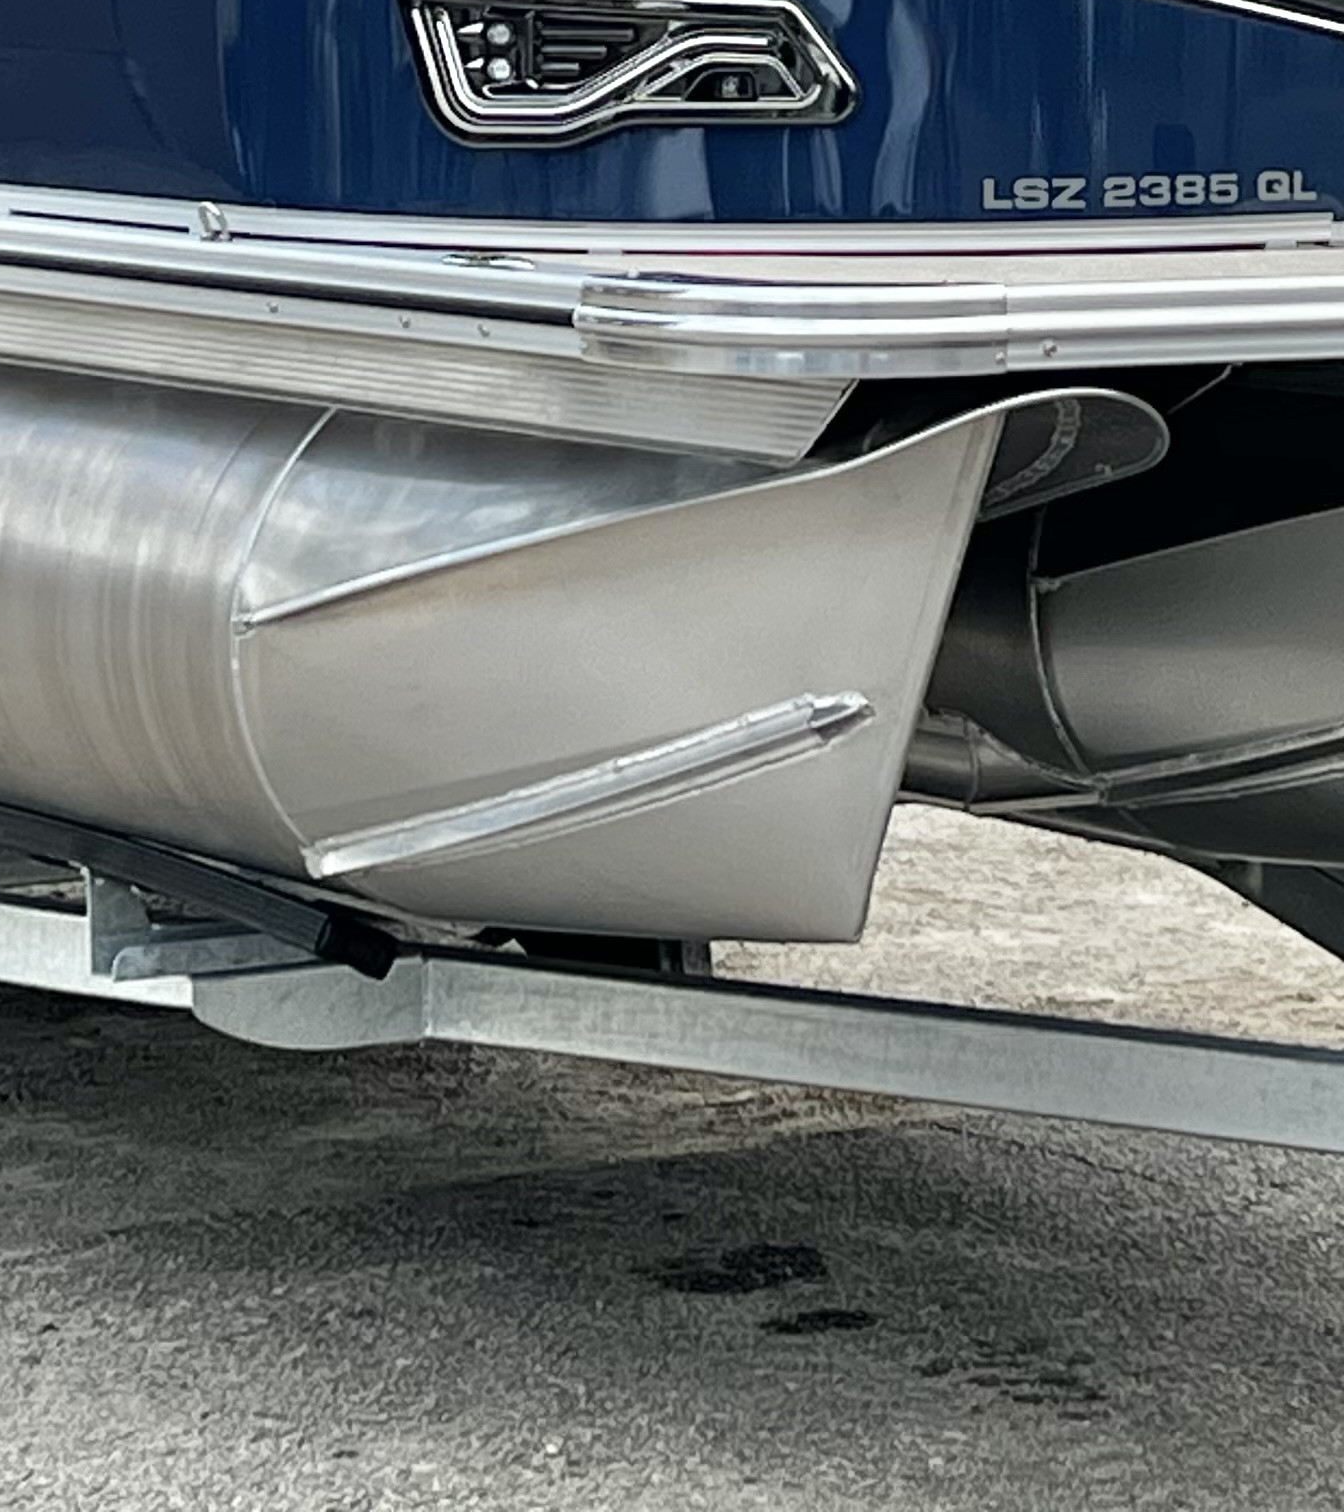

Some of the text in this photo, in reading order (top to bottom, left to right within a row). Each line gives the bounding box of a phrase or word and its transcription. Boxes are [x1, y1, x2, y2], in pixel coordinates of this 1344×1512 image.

[982, 170, 1317, 209] LSZ 2385 QL
